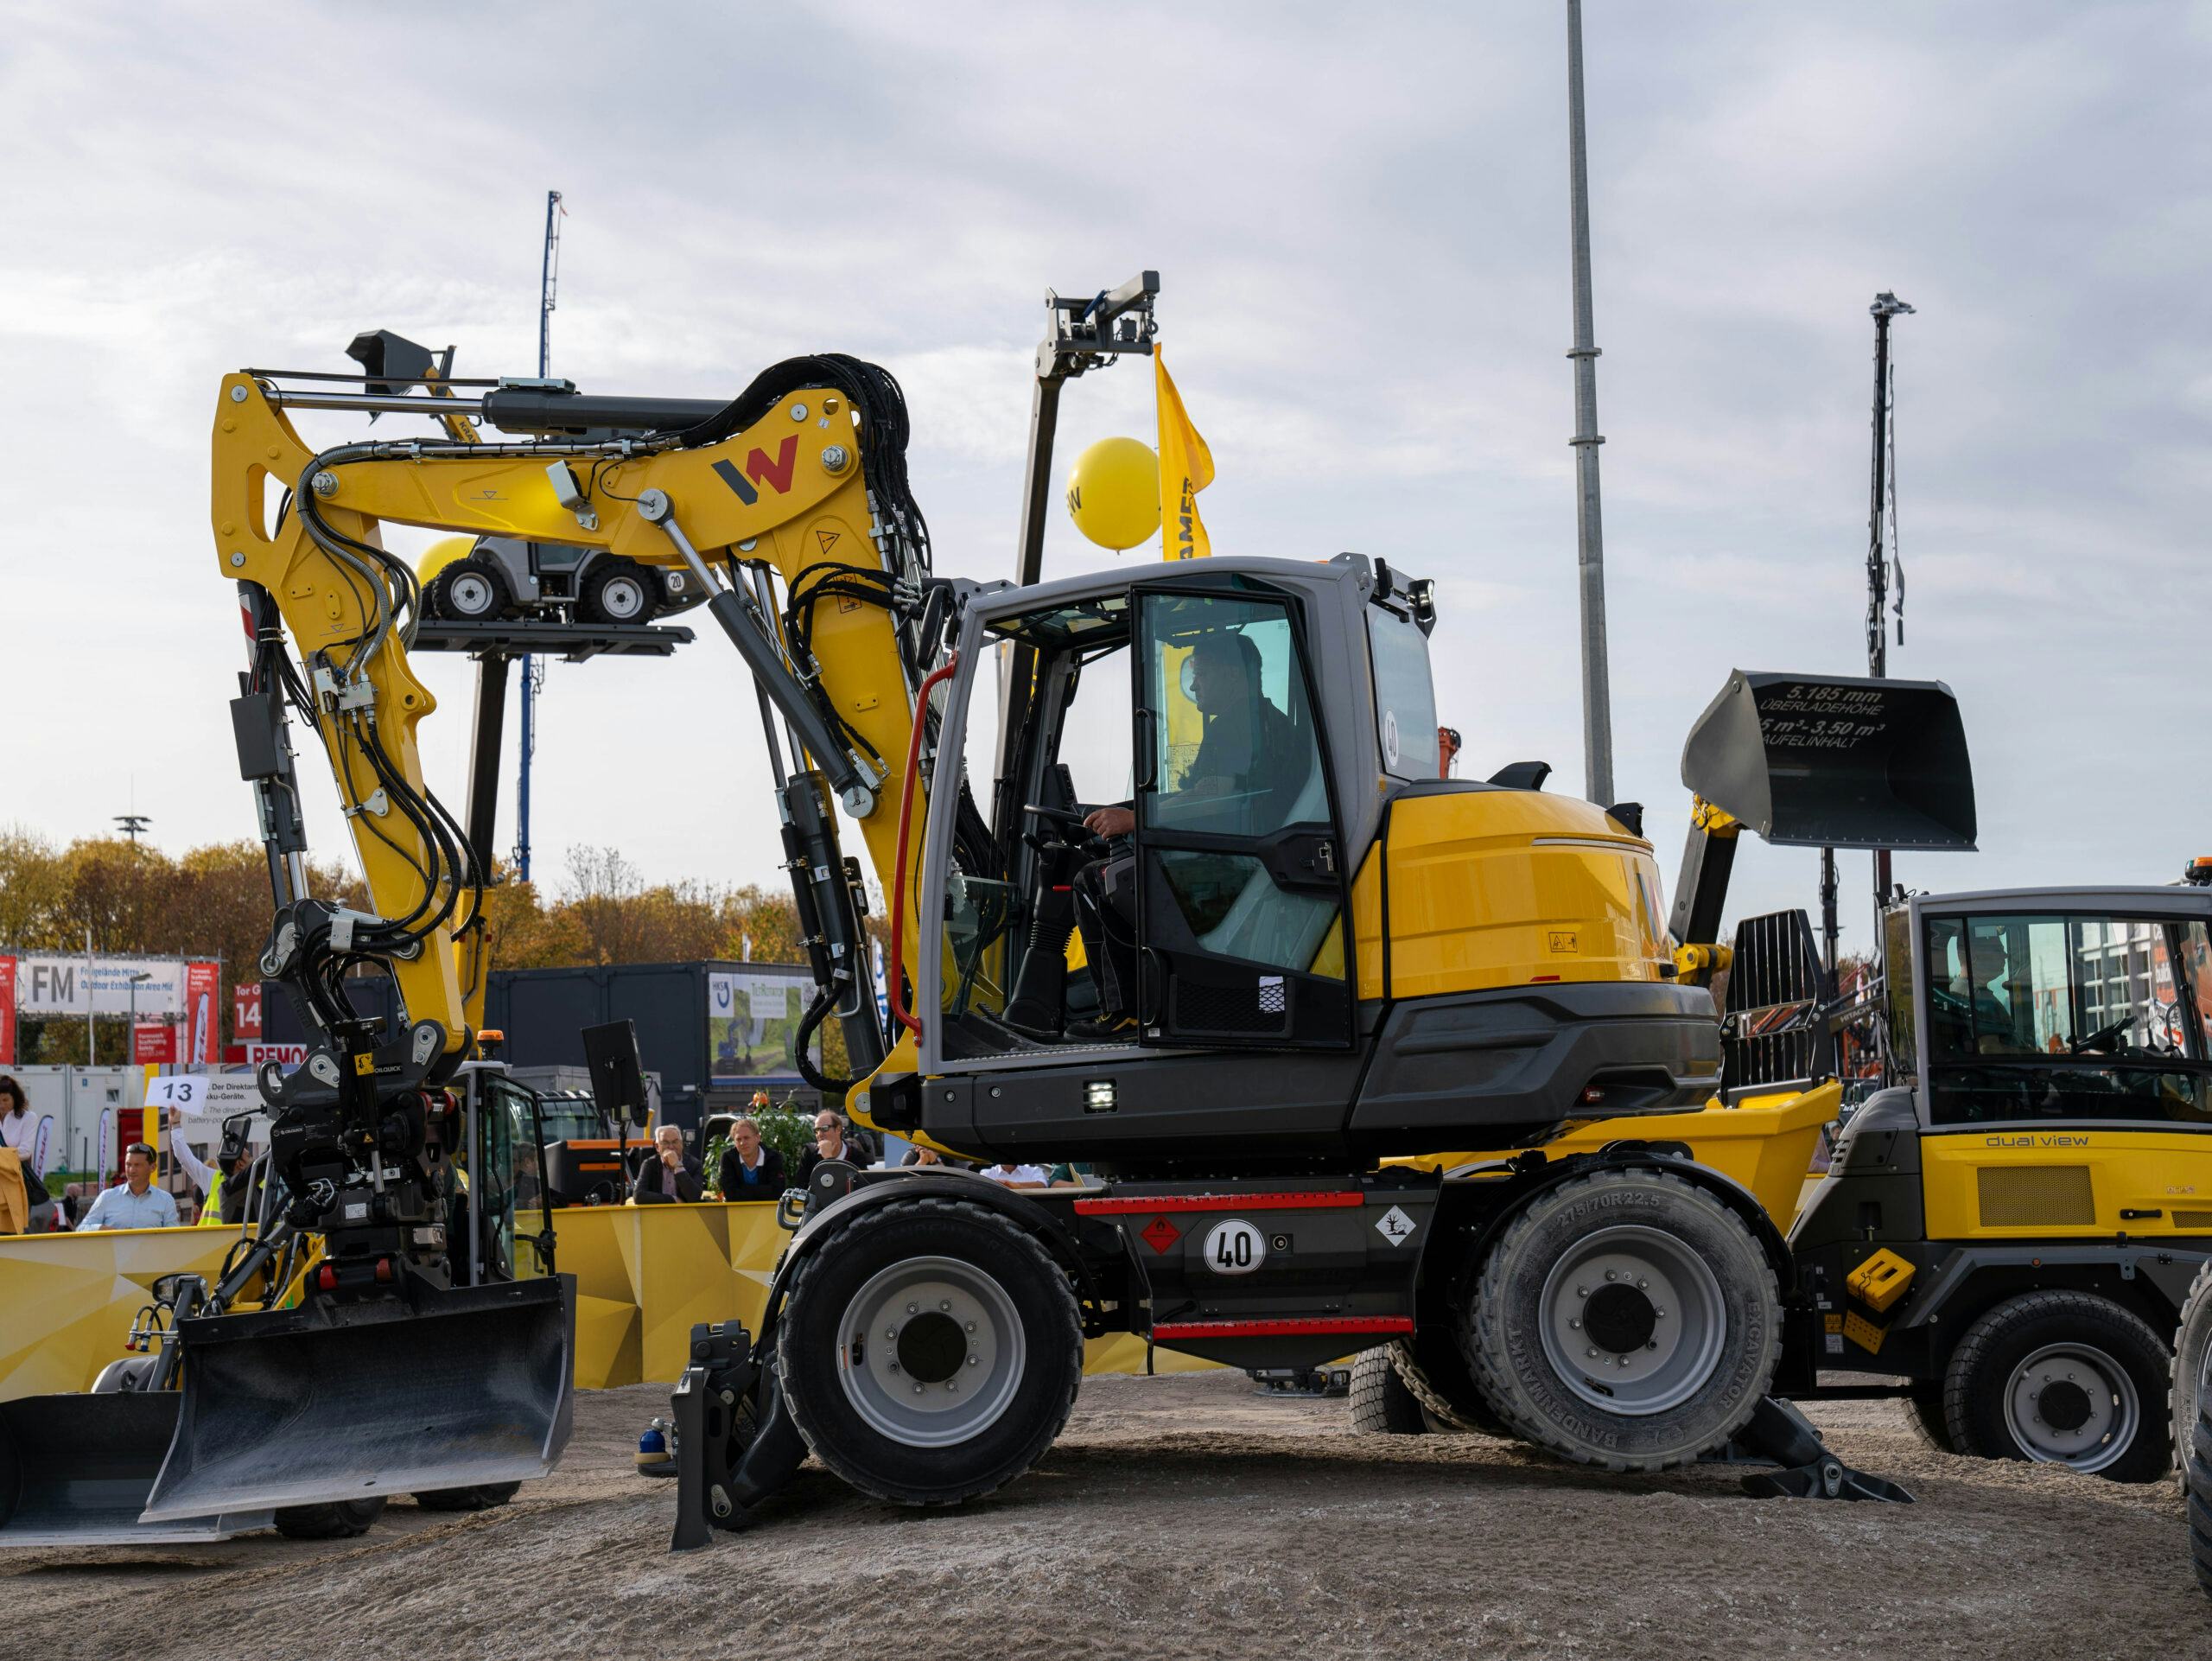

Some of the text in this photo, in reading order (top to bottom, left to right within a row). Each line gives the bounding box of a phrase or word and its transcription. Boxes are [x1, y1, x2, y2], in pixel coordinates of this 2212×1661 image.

[671, 575, 682, 589] 20
[1786, 685, 1883, 703] 5.185 mm
[1760, 697, 1885, 716] ÜBERLADEHÖHE
[1387, 718, 1397, 758] 40
[80, 966, 121, 977] Frigelände
[33, 965, 74, 1003] FM
[145, 982, 161, 991] Area
[162, 982, 173, 992] Mid
[235, 985, 250, 996] Tor
[236, 1001, 262, 1028] 14
[1840, 1003, 1872, 1023] HITACHI
[162, 1083, 193, 1103] 13
[1986, 1135, 2089, 1147] dual view
[1556, 1192, 1661, 1227] 275/70R22.5
[1217, 1231, 1251, 1268] 40
[1720, 1301, 1763, 1410] EXCAVATOR
[1508, 1327, 1619, 1448] BANDENMARKT
